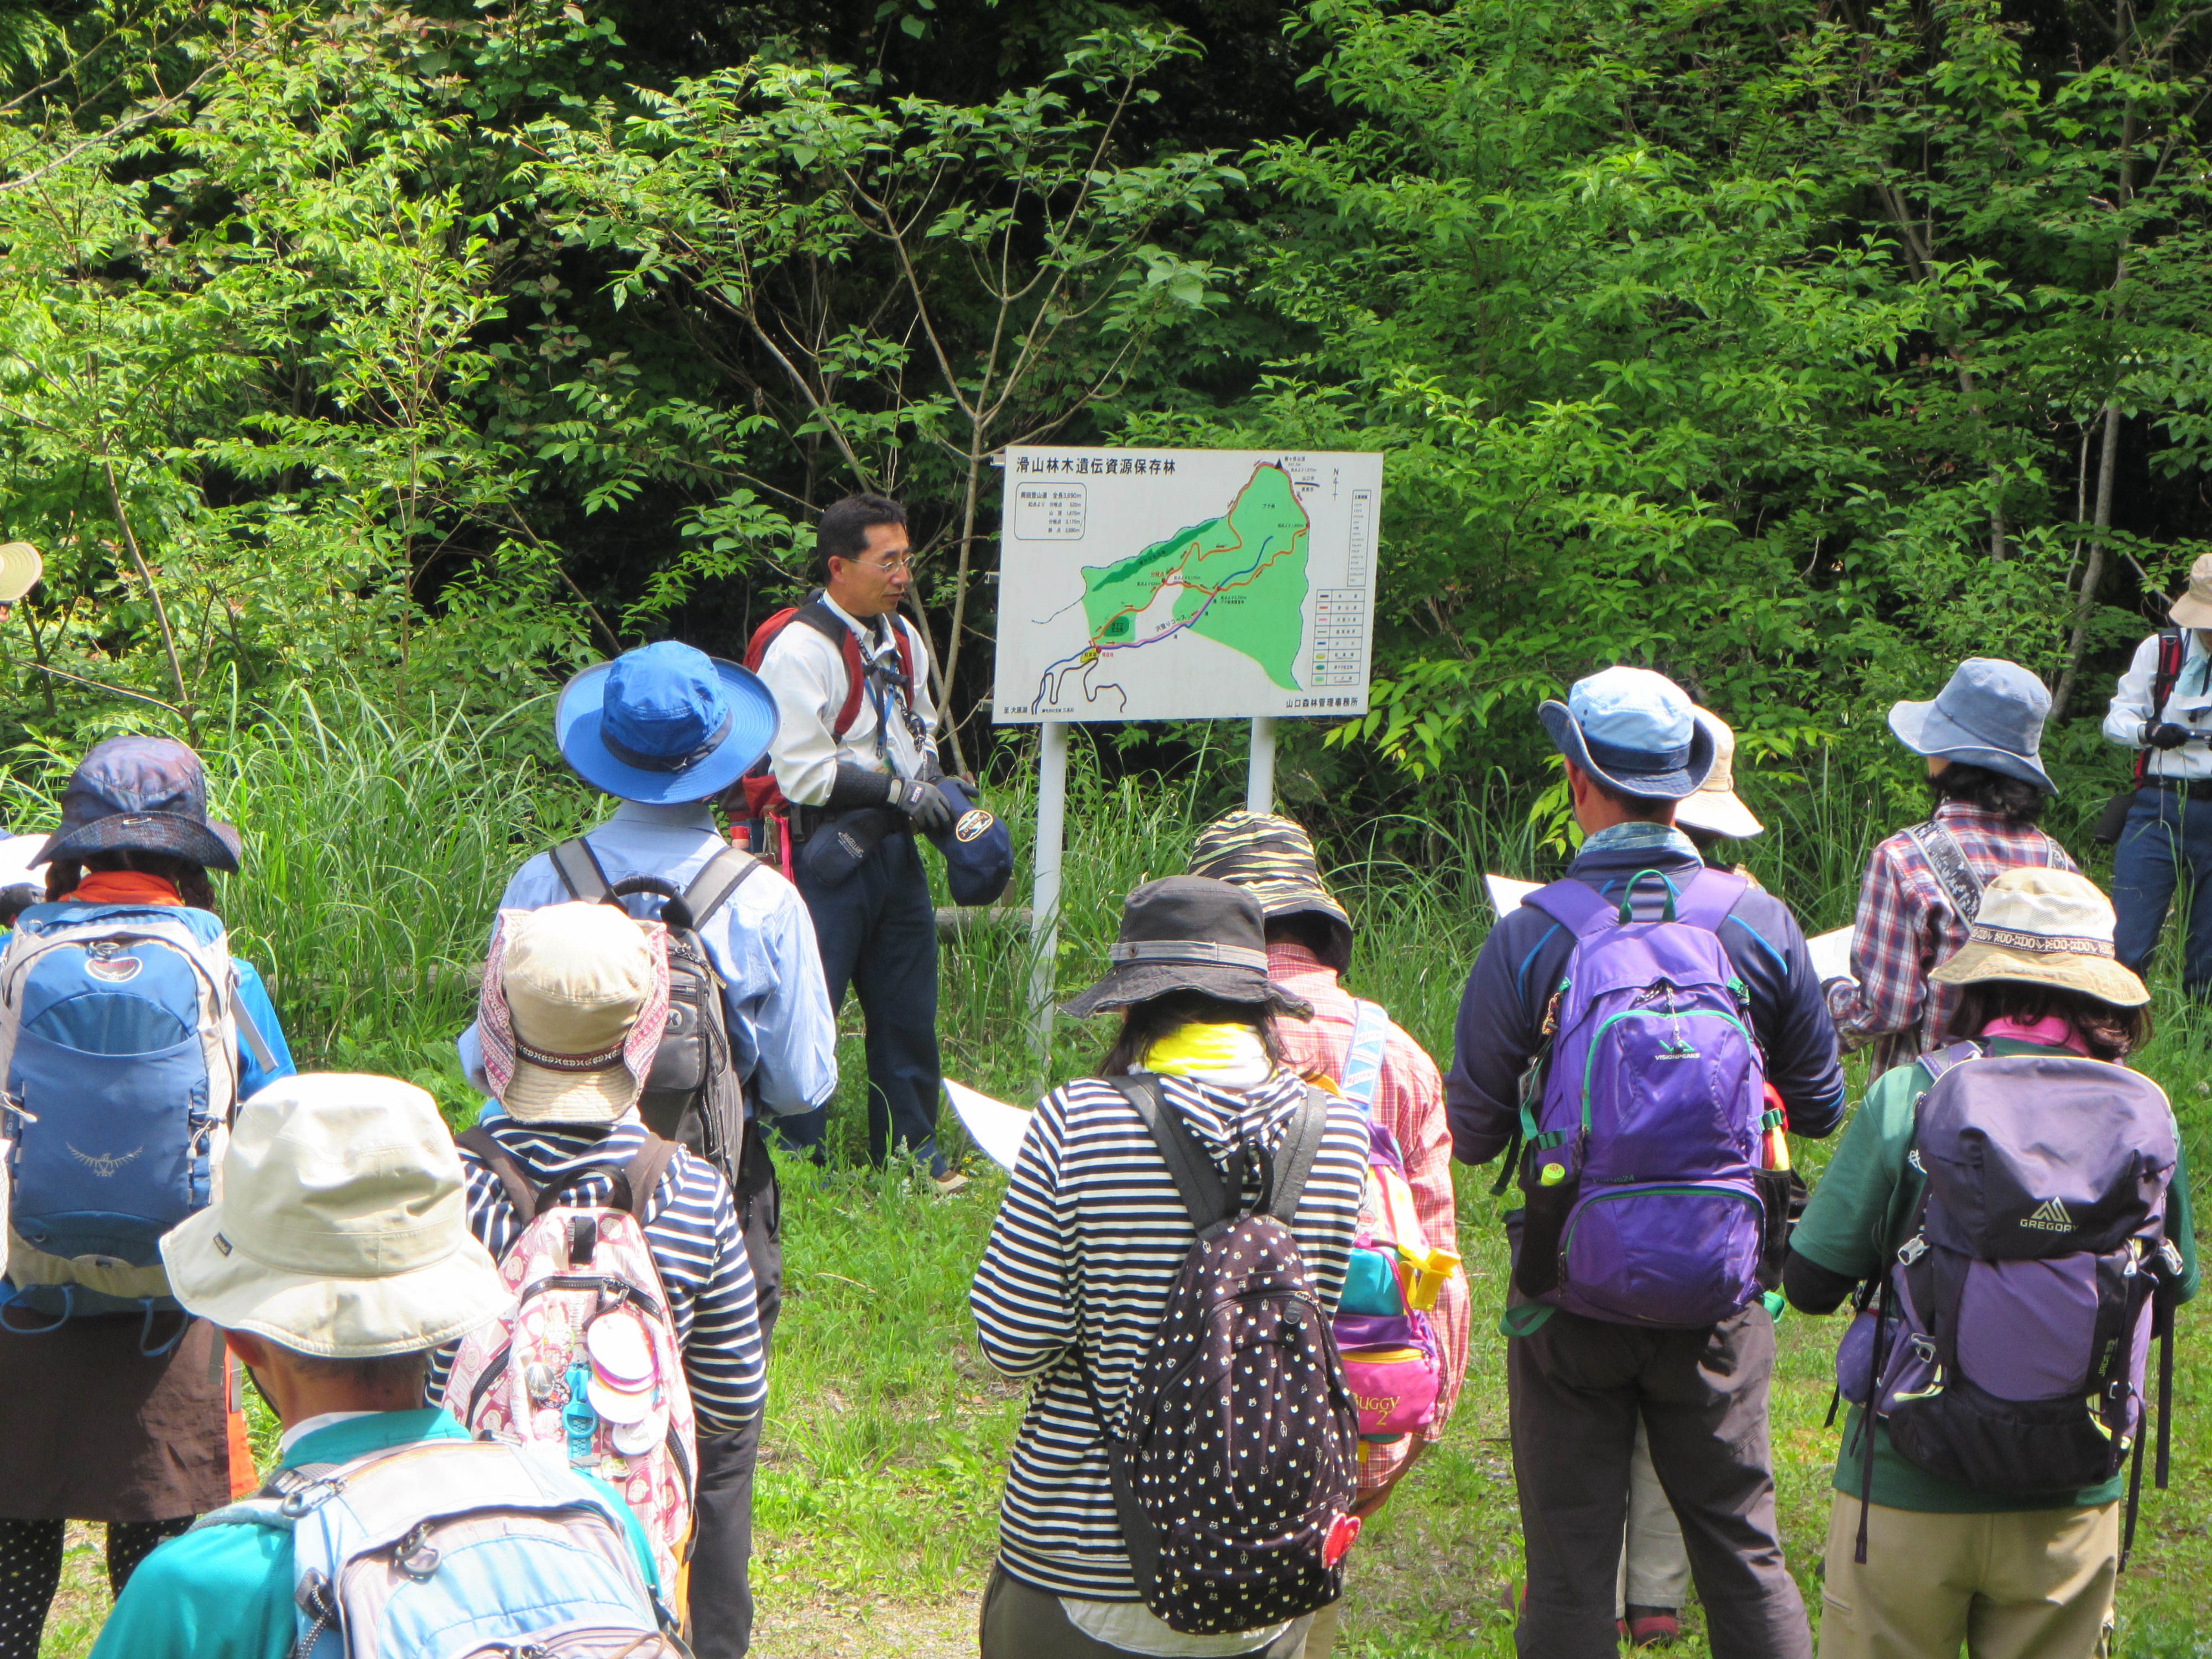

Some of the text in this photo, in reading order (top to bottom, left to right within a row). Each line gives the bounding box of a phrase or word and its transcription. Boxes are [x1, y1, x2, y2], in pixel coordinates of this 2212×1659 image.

[1016, 456, 1176, 475] 滑山林木遺伝資源保存林
[1286, 697, 1359, 708] 山口森林管理事務所
[2020, 1218, 2079, 1233] GREGORY
[1376, 1410, 1388, 1426] 2
